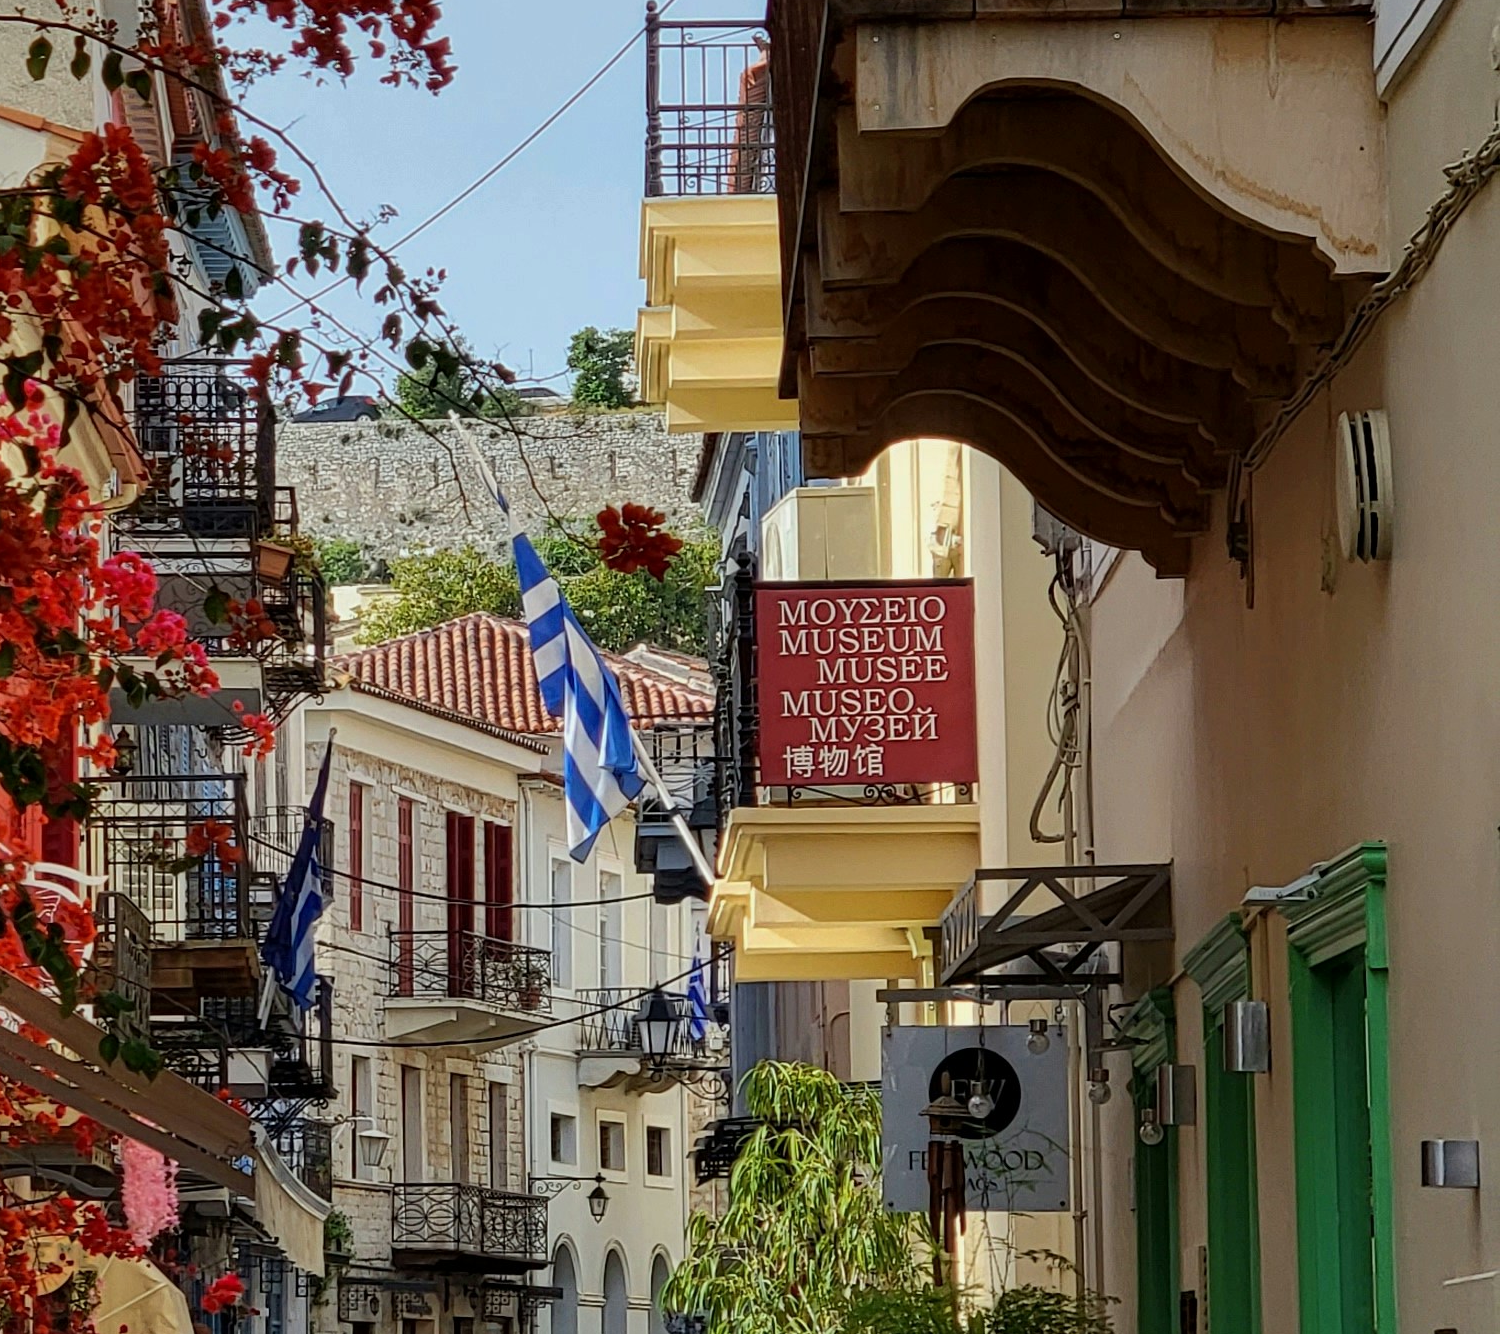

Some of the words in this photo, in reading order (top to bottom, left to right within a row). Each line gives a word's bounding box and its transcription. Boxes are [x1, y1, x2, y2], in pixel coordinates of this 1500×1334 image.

[777, 596, 947, 627] ΜΟΥΣΕΙΟ
[779, 625, 944, 656] MUSEUM
[816, 652, 949, 685] MUSÉE
[781, 687, 915, 717] MUSEO
[809, 706, 939, 743] МУЗЕЙ
[782, 744, 884, 778] 博物馆
